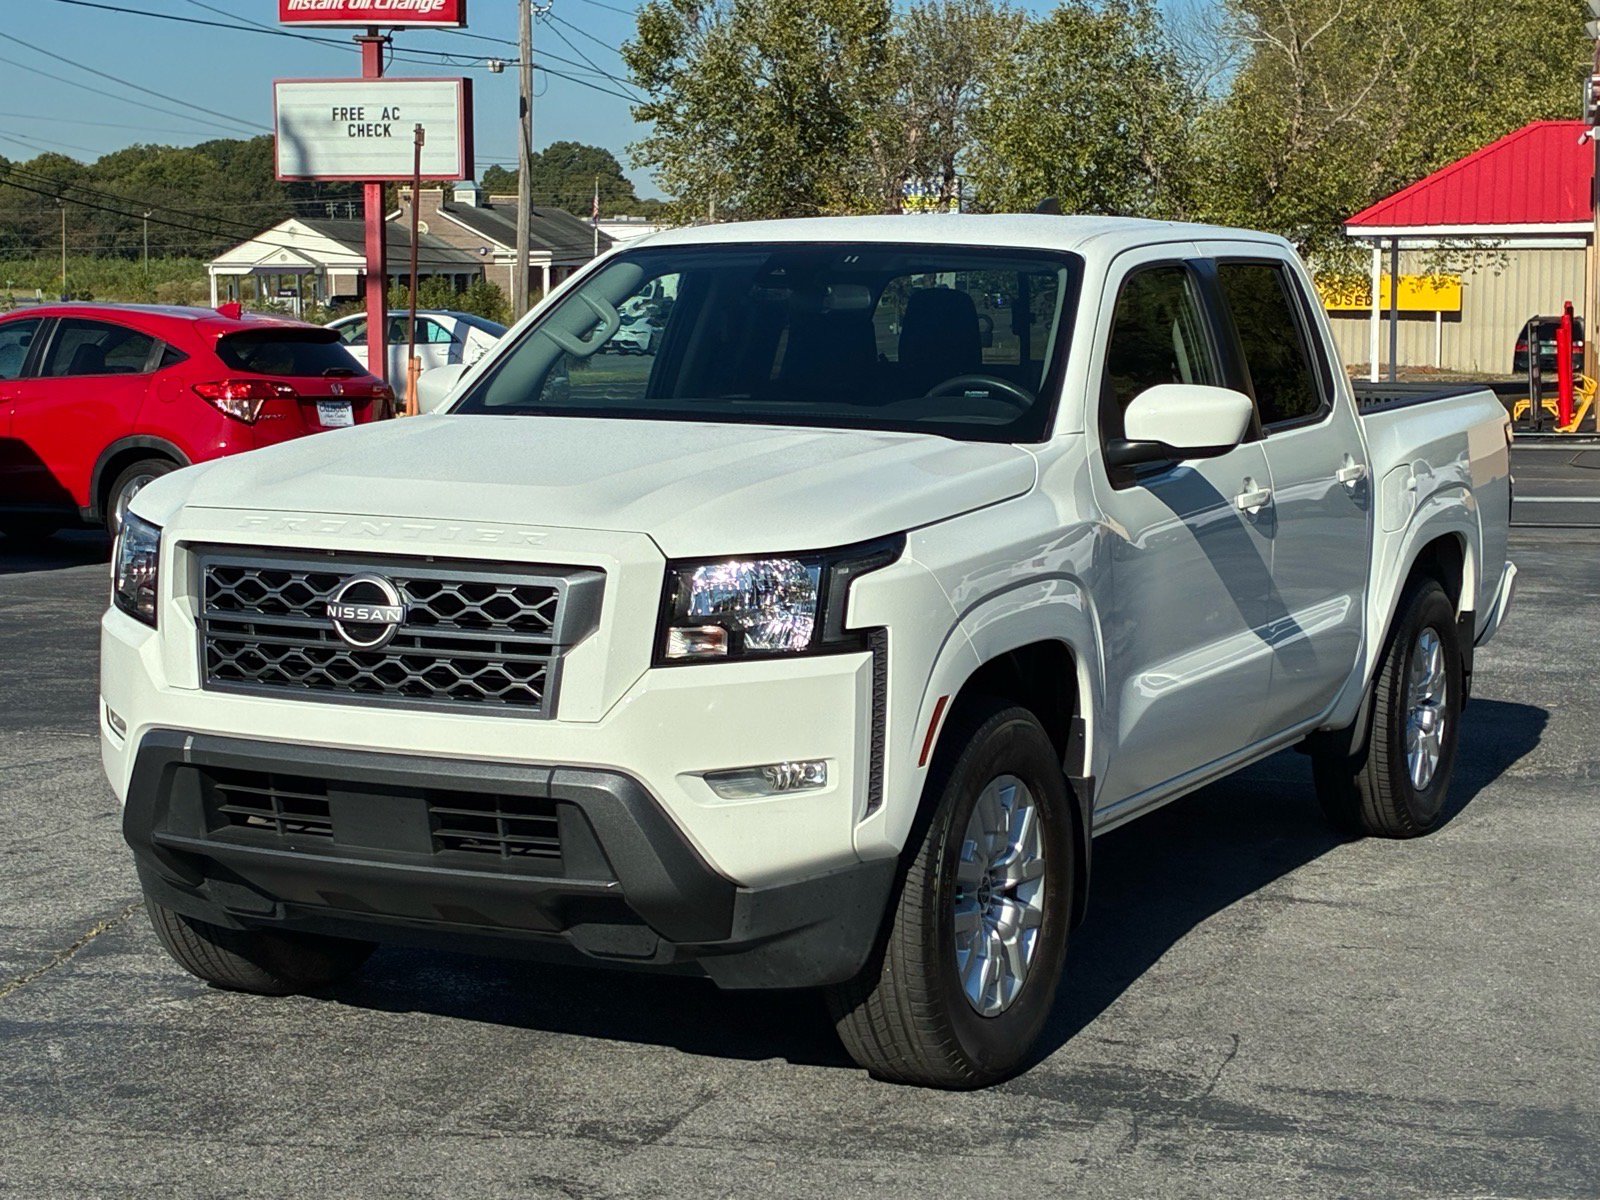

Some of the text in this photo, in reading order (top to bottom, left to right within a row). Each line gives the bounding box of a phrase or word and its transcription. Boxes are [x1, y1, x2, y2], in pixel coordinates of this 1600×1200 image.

[287, 0, 344, 10] Instant
[374, 0, 444, 13] Change
[332, 106, 400, 121] FREE AC
[347, 124, 391, 137] CHECK
[236, 516, 549, 545] FRONTIER
[327, 604, 401, 622] NISSAN
